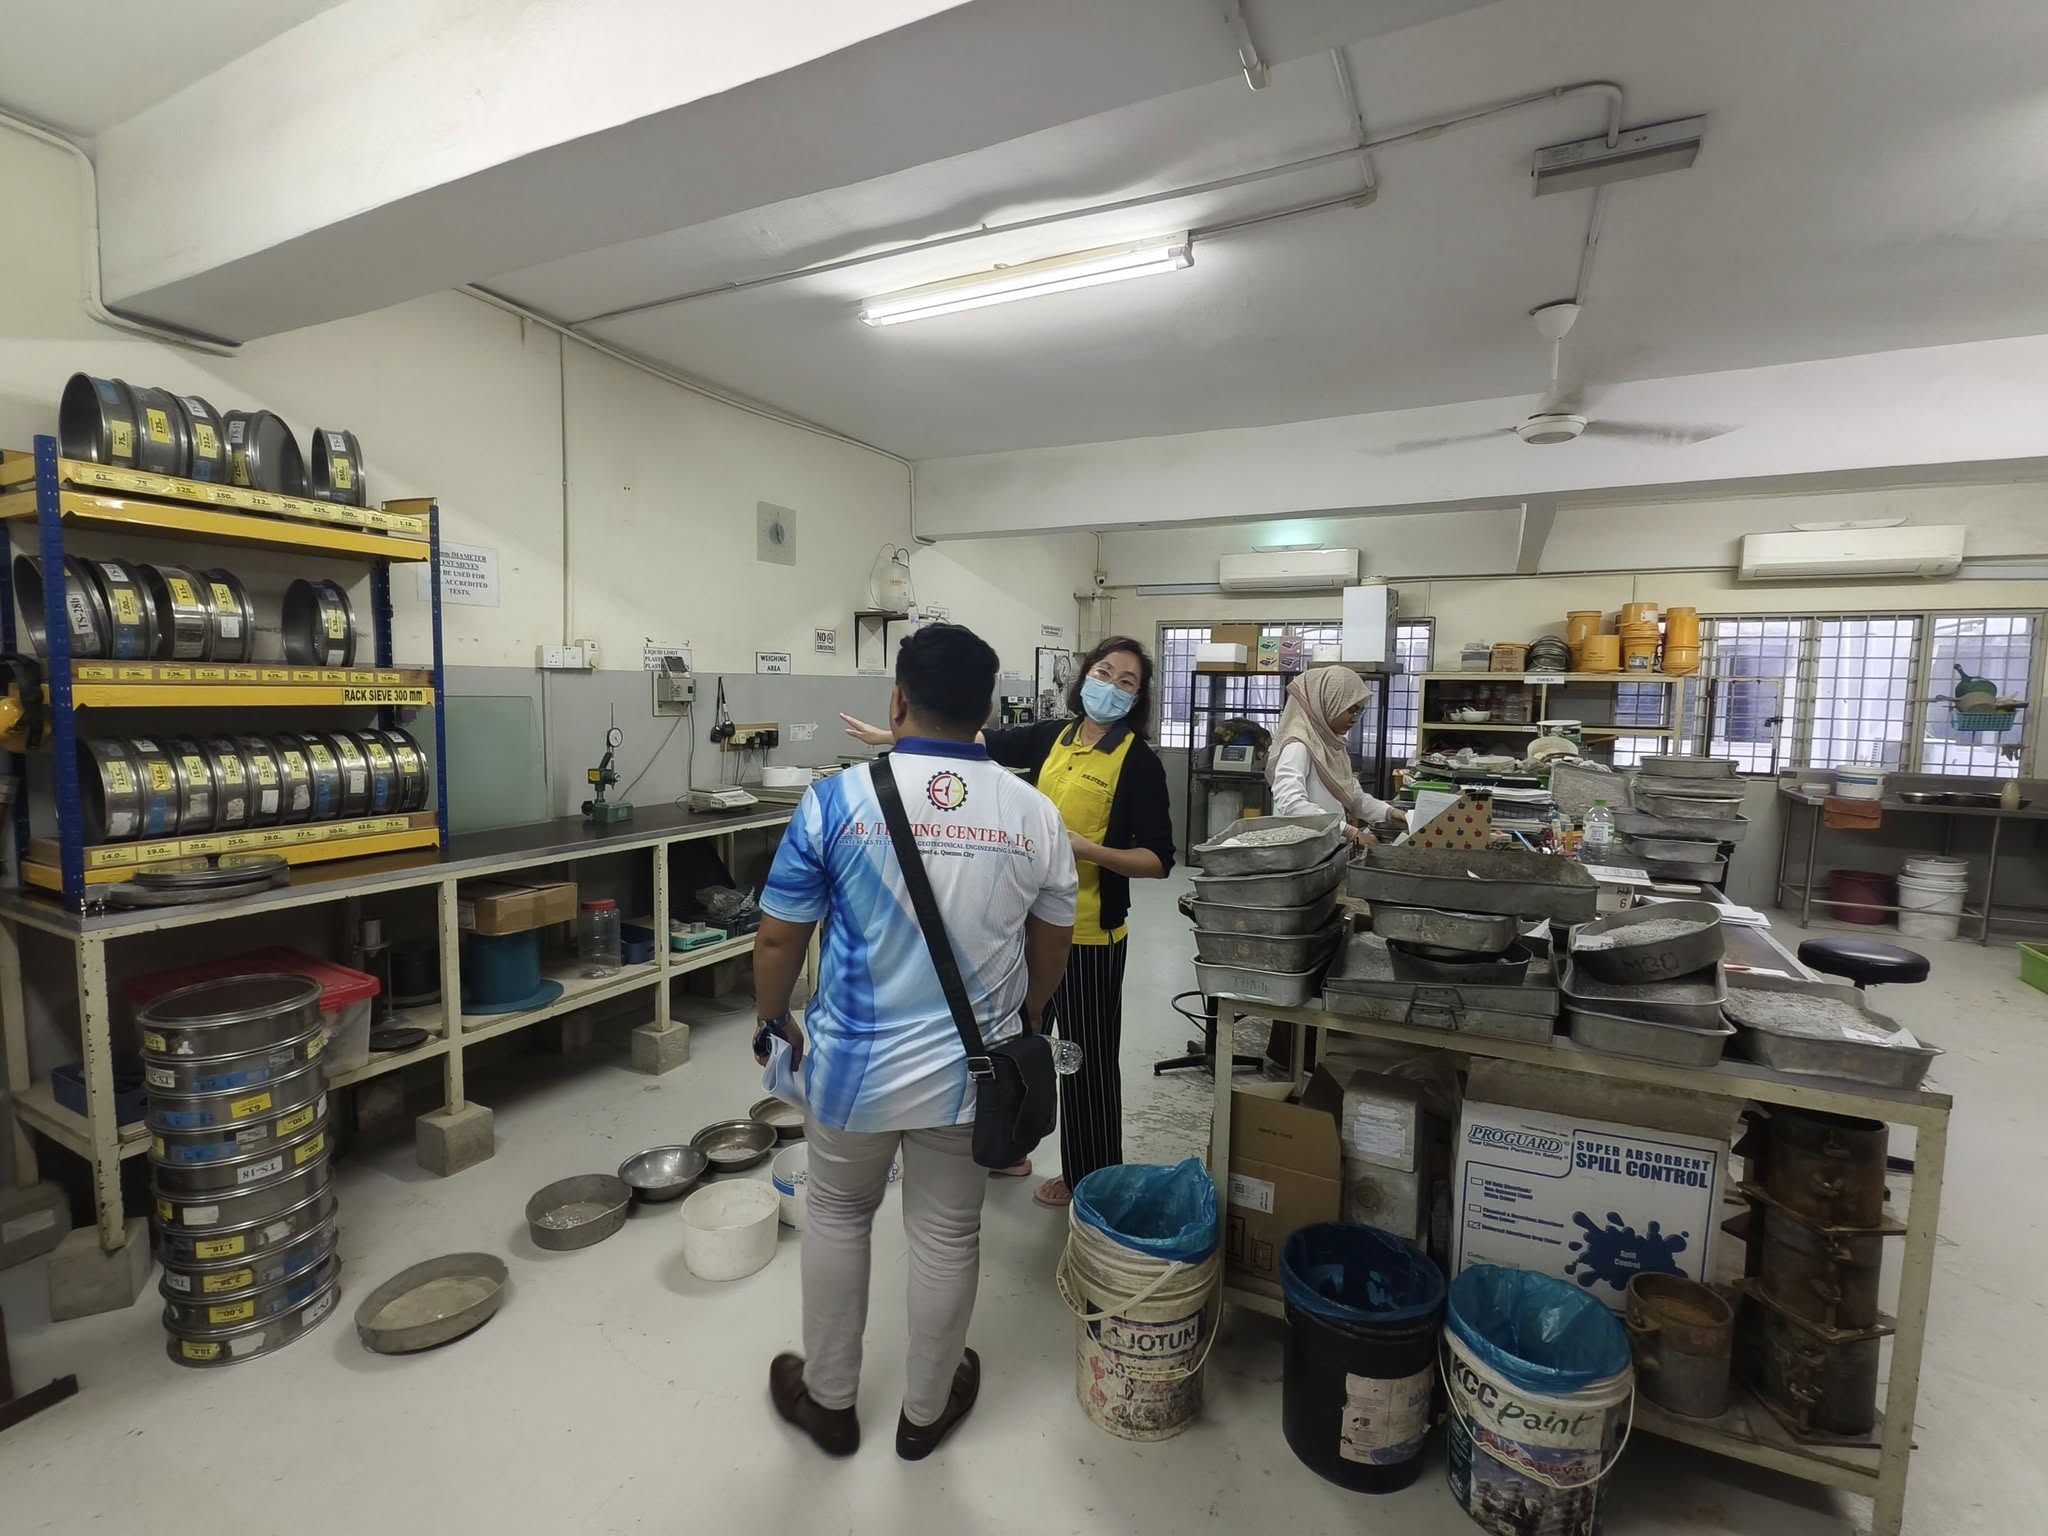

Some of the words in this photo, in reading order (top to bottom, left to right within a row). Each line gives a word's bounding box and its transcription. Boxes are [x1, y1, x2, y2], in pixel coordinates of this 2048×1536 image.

[453, 570, 471, 579] USED
[472, 572, 486, 580] FOR
[445, 579, 488, 588] ACCREDITED
[817, 632, 826, 641] NO
[761, 655, 787, 663] WEIGHING
[767, 664, 781, 672] AREA
[344, 690, 367, 701] RACK
[369, 690, 392, 701] SIEVE
[394, 690, 408, 701] 300
[410, 690, 423, 701] mm
[946, 825, 1011, 848] CENTER,
[917, 841, 964, 850] GEOTECHNICAL
[965, 844, 1007, 853] ENGINEERING
[1470, 1125, 1561, 1152] PROGUARD
[1511, 1146, 1533, 1154] Partner
[1542, 1152, 1563, 1160] Safety
[1576, 1140, 1620, 1157] SUPER
[1625, 1148, 1711, 1171] ABSORBENT
[242, 1163, 276, 1179] TS-18
[1575, 1152, 1622, 1174] SPILL
[1625, 1161, 1708, 1189] CONTROL
[1620, 1250, 1637, 1260] Spill
[1614, 1258, 1640, 1269] Control
[1127, 1325, 1196, 1352] JOTUN
[1452, 1355, 1499, 1409] KCC
[1498, 1402, 1595, 1437] Paint
